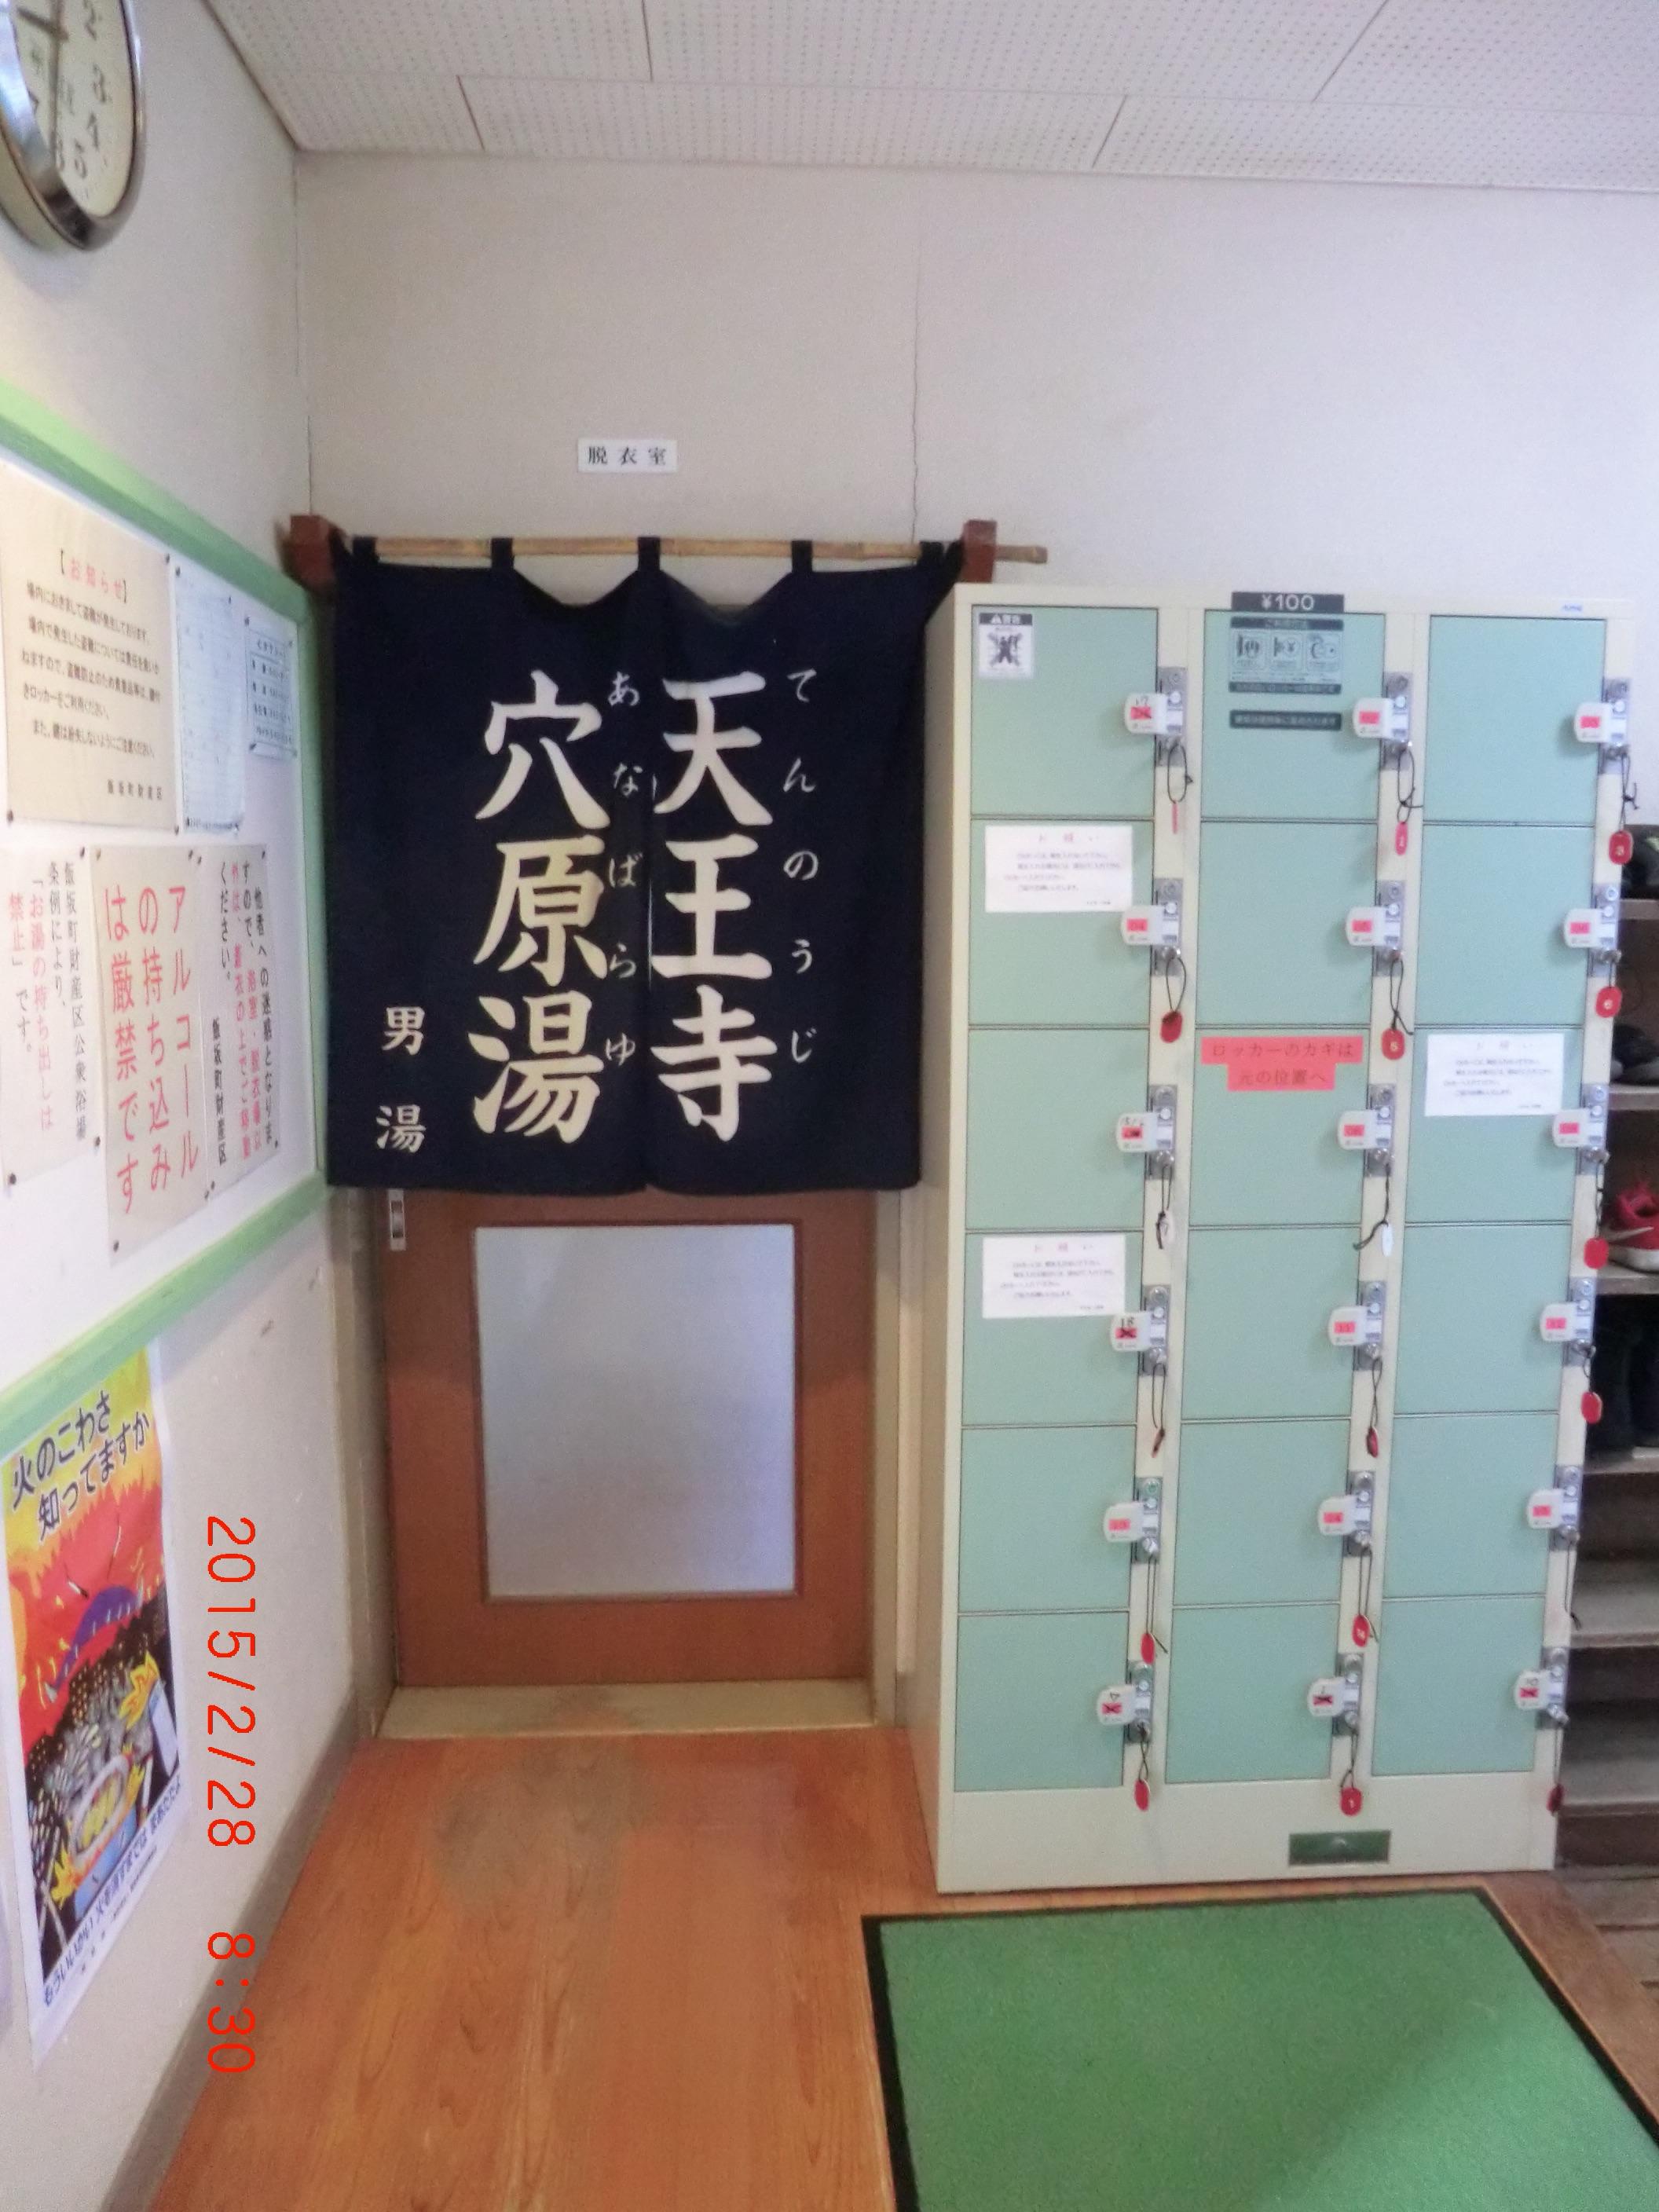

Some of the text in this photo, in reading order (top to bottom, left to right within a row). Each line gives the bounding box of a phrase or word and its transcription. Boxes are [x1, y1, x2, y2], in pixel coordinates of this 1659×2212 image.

[588, 445, 666, 466] 脱衣室
[1261, 594, 1316, 612] ¥100
[467, 669, 611, 1144] 穴原湯
[604, 671, 642, 1067] あなばらゆ
[650, 670, 777, 1142] 天王寺
[783, 668, 819, 1066] てんのうじ
[105, 884, 138, 1214] は厳禁です
[138, 887, 171, 1191] の持ち込み
[168, 886, 199, 1178] アルコール
[375, 1005, 427, 1153] 男湯
[1212, 1042, 1354, 1057] ロッカーのカギは
[1240, 1068, 1326, 1086] 元の位置へ
[13, 1390, 111, 1511] 火のこわさ
[39, 1411, 150, 1542] 知ってますか
